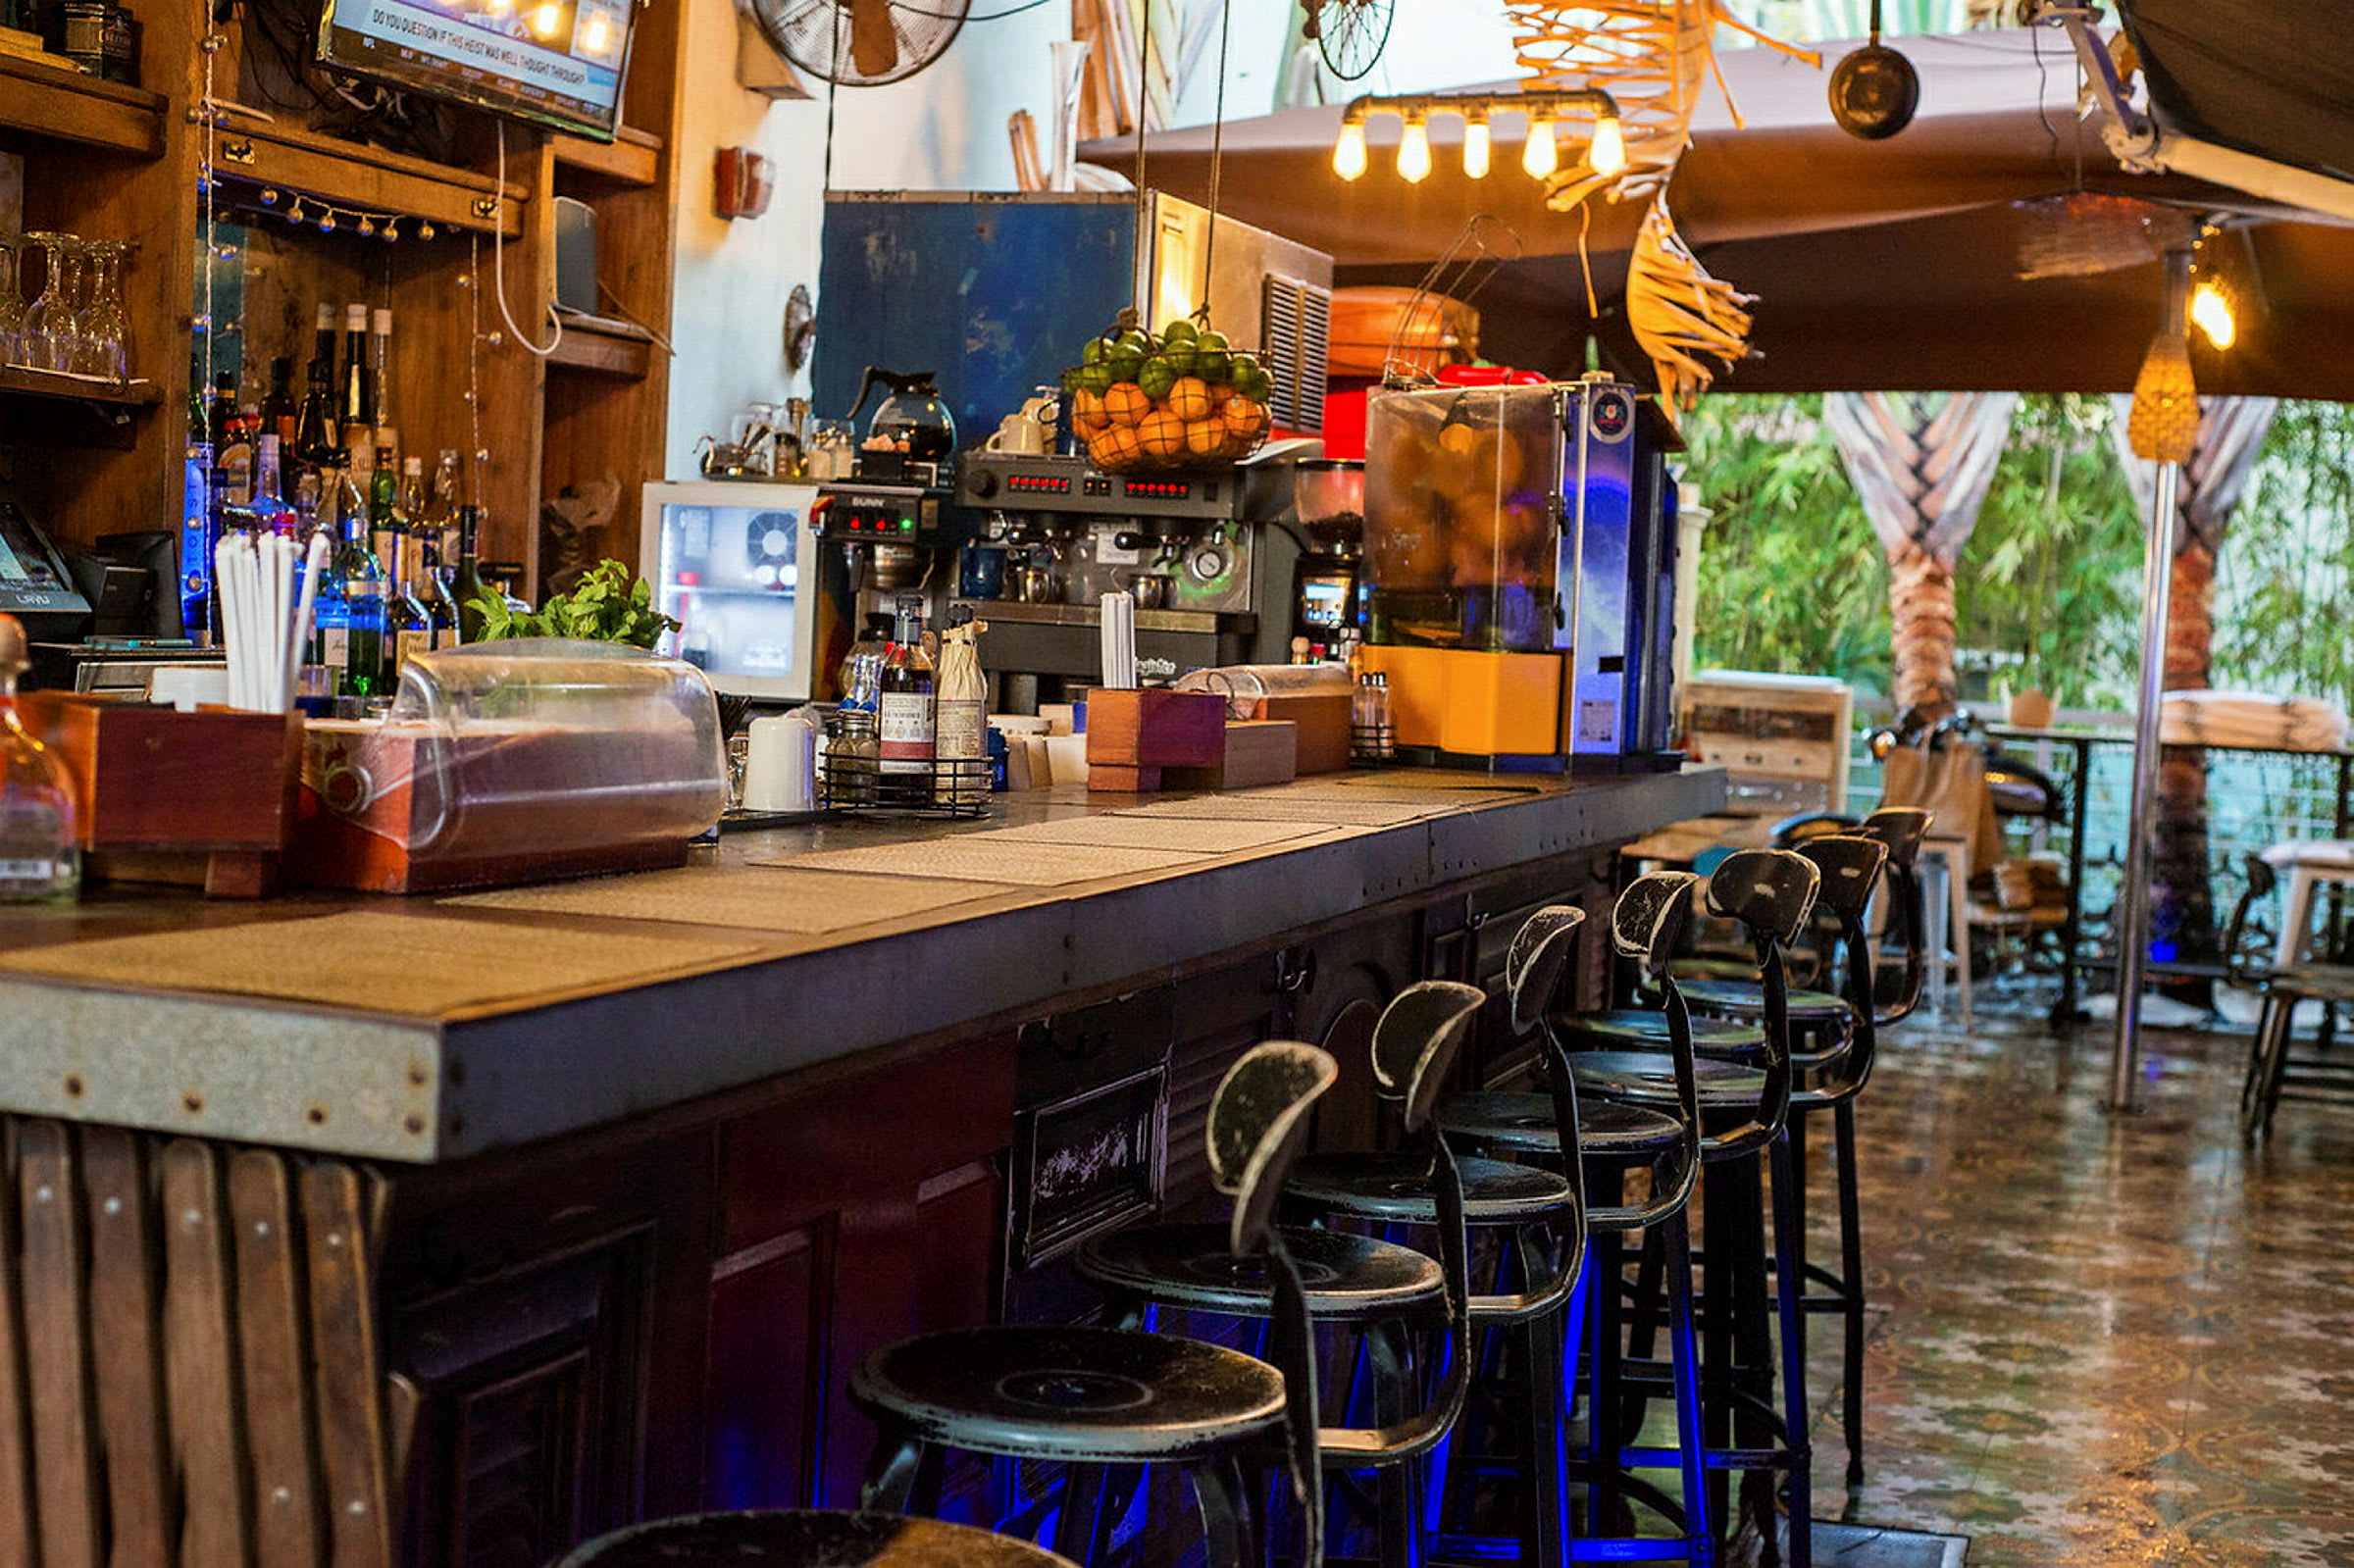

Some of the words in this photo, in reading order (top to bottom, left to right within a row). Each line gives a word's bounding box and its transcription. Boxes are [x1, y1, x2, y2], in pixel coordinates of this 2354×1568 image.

[373, 9, 385, 25] DO
[385, 13, 401, 30] YOU
[401, 18, 437, 40] QUESTION
[448, 31, 464, 49] THIS
[464, 38, 486, 55] HEIST
[486, 44, 501, 59] WAS
[501, 49, 519, 67] WELL
[520, 55, 550, 76] THOUGHT
[550, 64, 587, 85] THROUGH?
